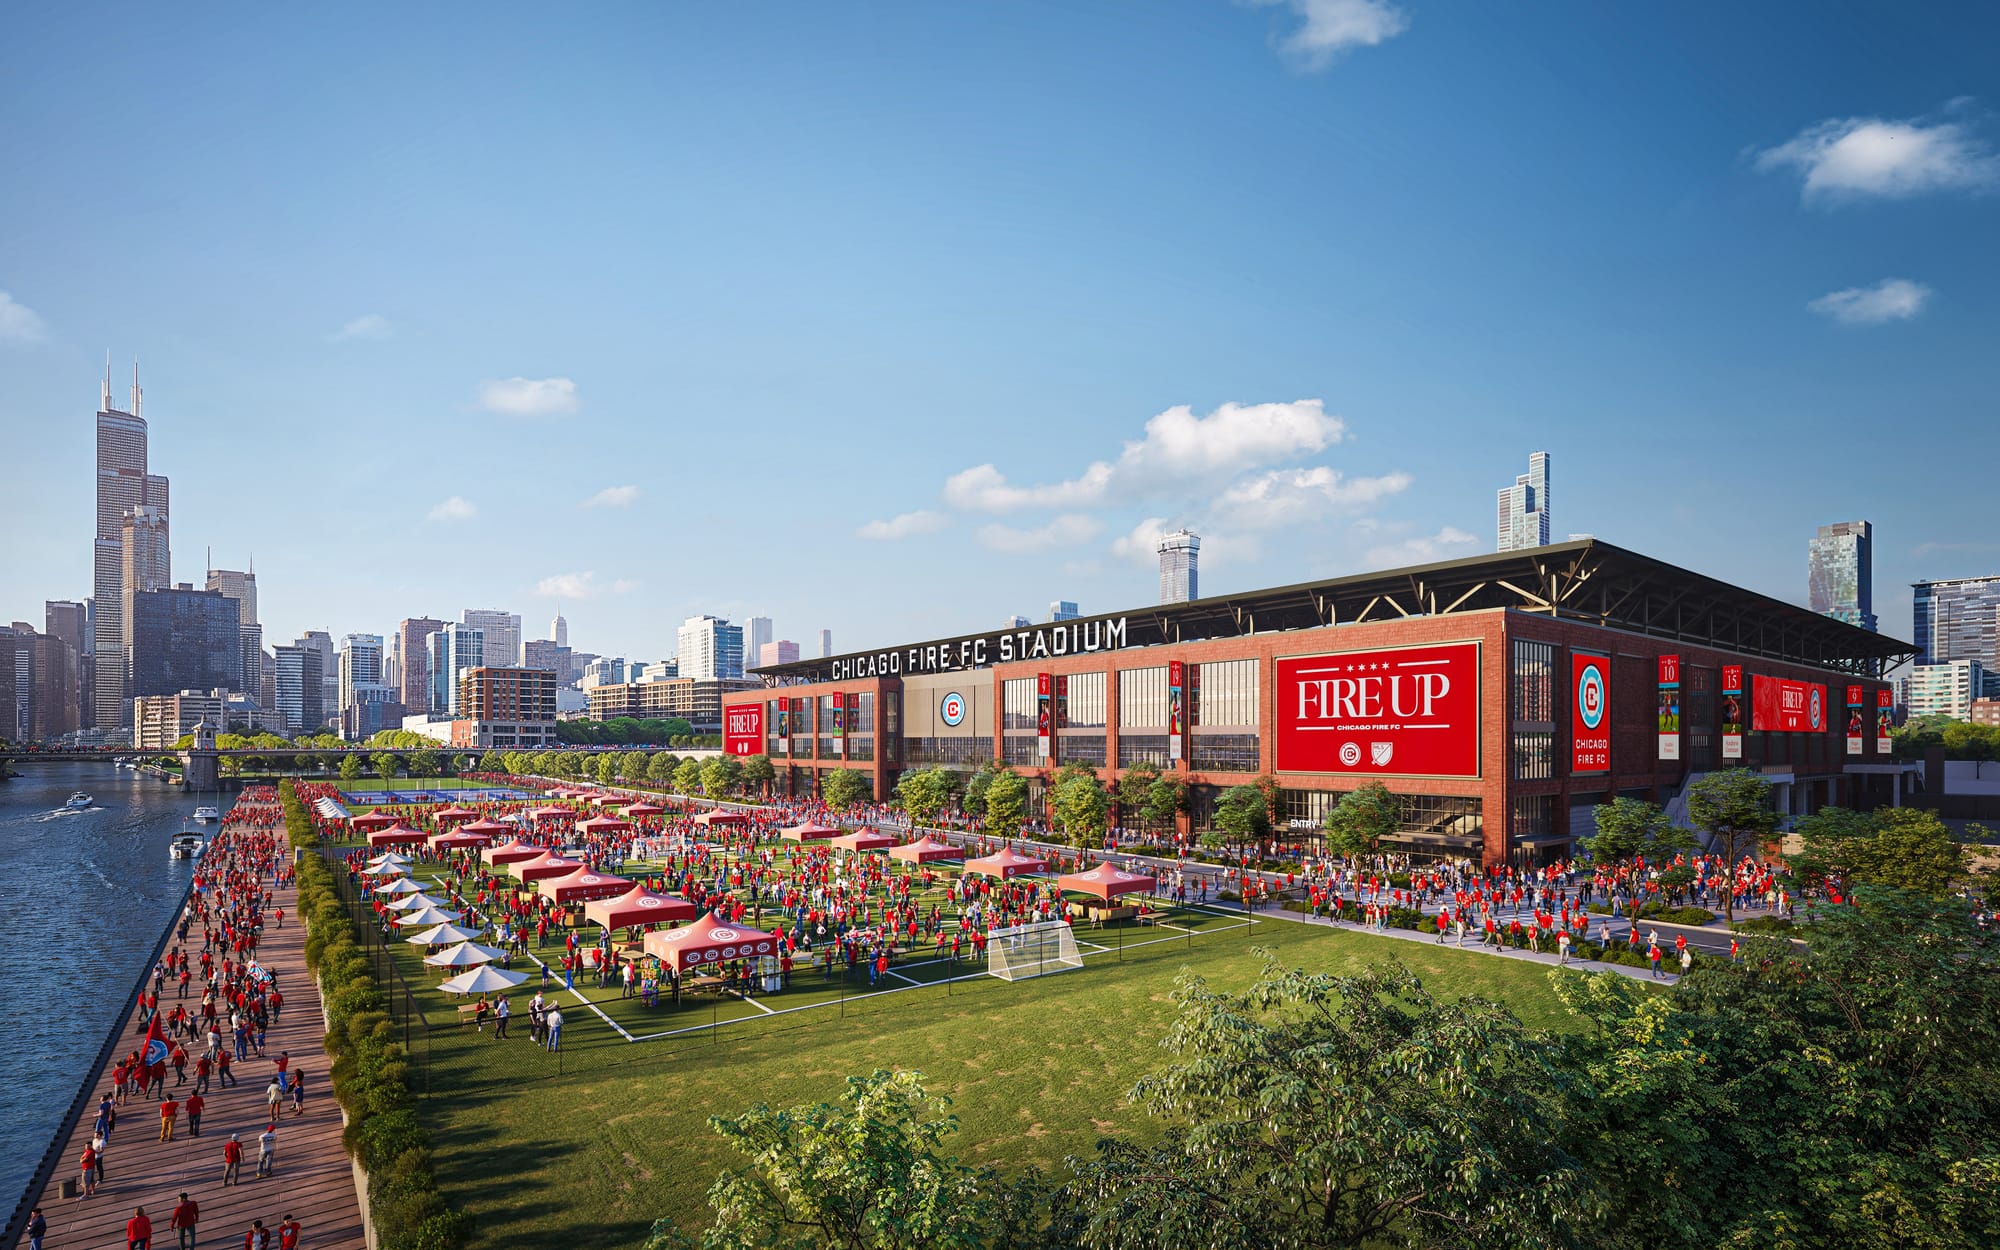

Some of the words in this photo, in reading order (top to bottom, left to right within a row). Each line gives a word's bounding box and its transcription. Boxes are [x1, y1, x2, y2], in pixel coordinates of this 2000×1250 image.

[832, 652, 900, 680] CHICAGO
[909, 644, 950, 671] FIRE
[961, 639, 986, 665] FC
[1000, 617, 1127, 660] STADIUM
[1664, 665, 1675, 681] 10
[1727, 675, 1737, 688] 15
[1296, 675, 1384, 720] FIRE
[1388, 673, 1450, 717] UP
[1852, 693, 1857, 702] 9
[1881, 697, 1889, 706] 19
[729, 714, 747, 733] FIRE
[747, 714, 758, 732] UP
[1576, 739, 1607, 749] CHICAGO
[1578, 754, 1594, 764] FIRE
[1597, 754, 1605, 764] FC
[1290, 819, 1317, 829] ENTRY
